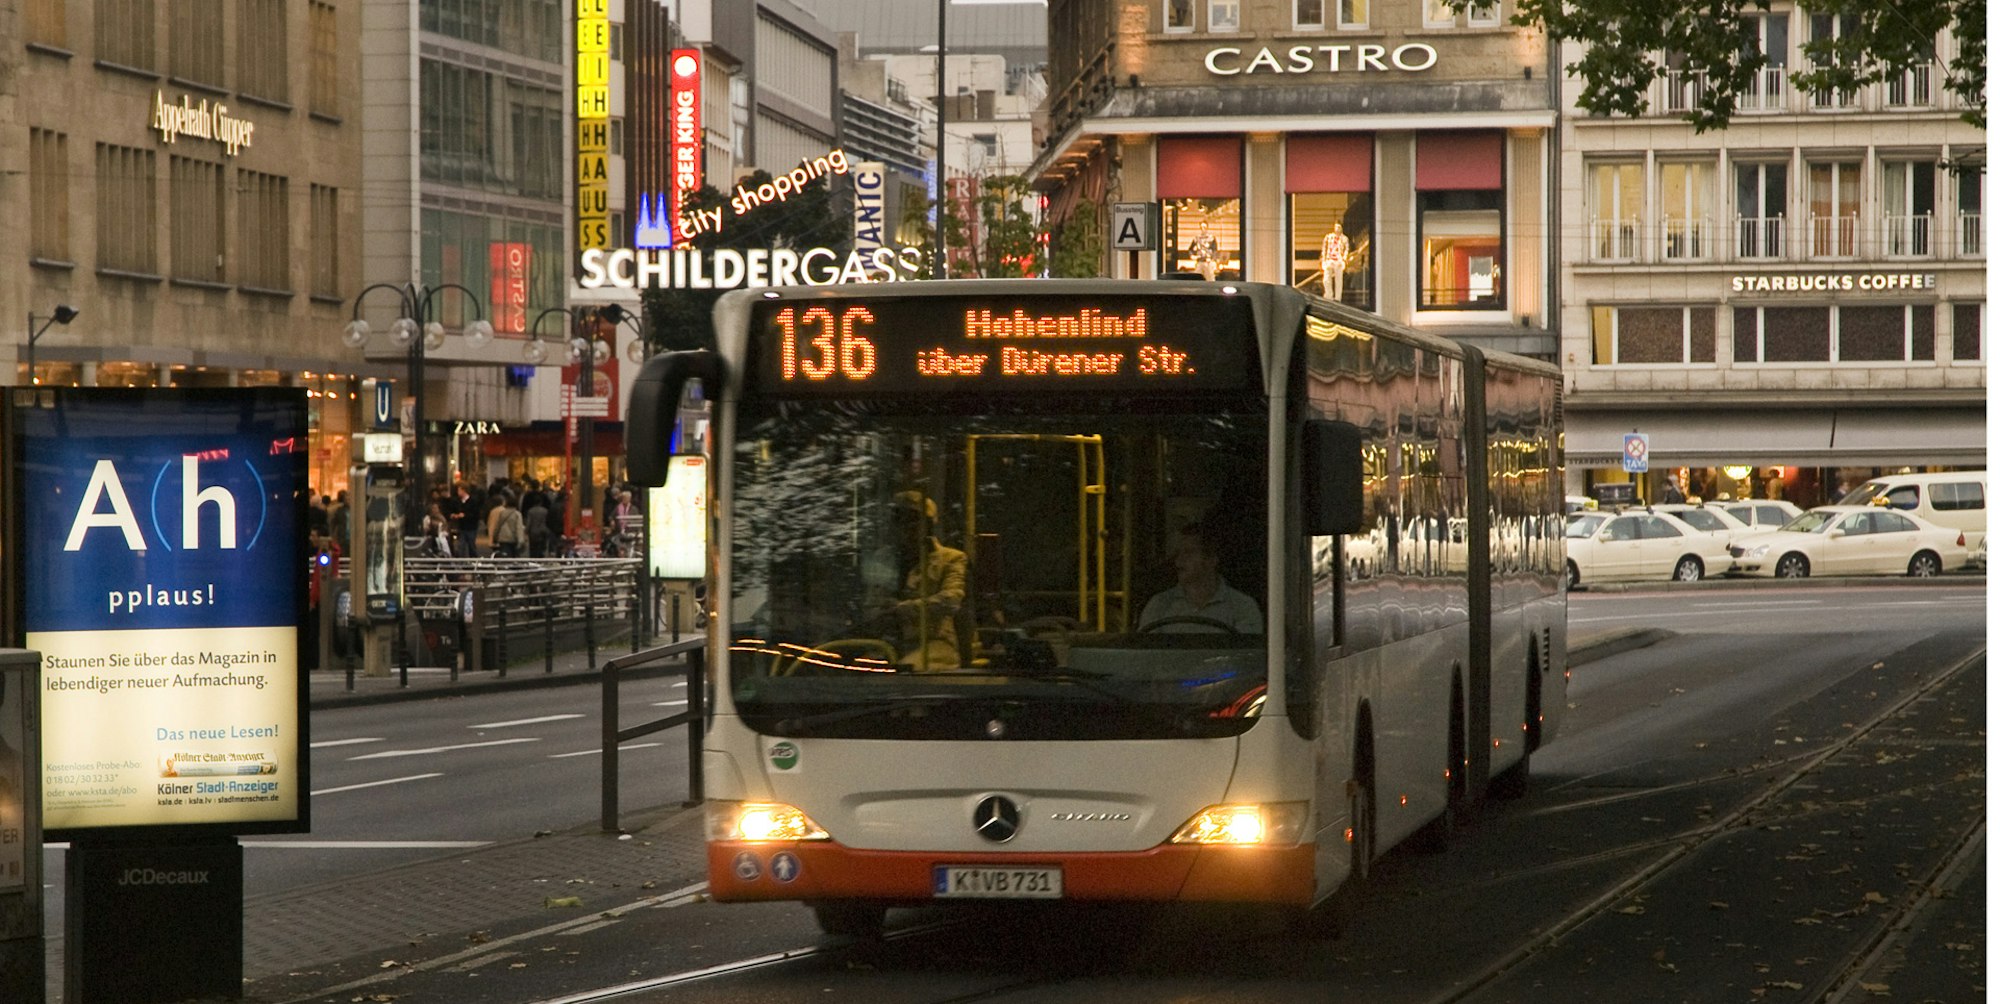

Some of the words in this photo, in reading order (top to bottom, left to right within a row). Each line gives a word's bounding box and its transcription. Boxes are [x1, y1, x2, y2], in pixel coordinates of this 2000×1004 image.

[1204, 43, 1438, 75] CASTRO
[153, 88, 211, 144] Appelrath
[212, 101, 254, 156] Cüpper
[677, 91, 694, 143] KING
[679, 206, 723, 240] city
[731, 149, 848, 215] shopping
[1118, 217, 1141, 243] A
[1732, 275, 1853, 291] STARBUCKS
[1858, 274, 1935, 290] COFFEE
[965, 308, 1147, 338] Hohenlind
[775, 307, 878, 380] 136
[916, 347, 988, 375] über
[1002, 346, 1125, 375] Dürener
[1139, 345, 1197, 374] Str.
[378, 387, 389, 422] U
[454, 421, 501, 434] ZARA
[109, 584, 214, 614] pplaus!
[46, 655, 105, 669] Staunen
[109, 653, 130, 668] Sie
[134, 652, 167, 667] über
[171, 651, 195, 666] das
[198, 651, 260, 669] Magazin
[263, 650, 277, 663] in
[46, 676, 124, 694] lebendiger
[127, 677, 169, 689] neuer
[172, 672, 269, 690] Aufmachung.
[157, 727, 184, 741] Das
[189, 729, 226, 739] neue
[231, 724, 279, 738] Lesen!
[46, 762, 95, 772] Kostenloses
[46, 788, 66, 797] oder
[157, 782, 193, 795] Kölner
[2, 829, 19, 844] ER
[118, 869, 209, 885] JCDecaux
